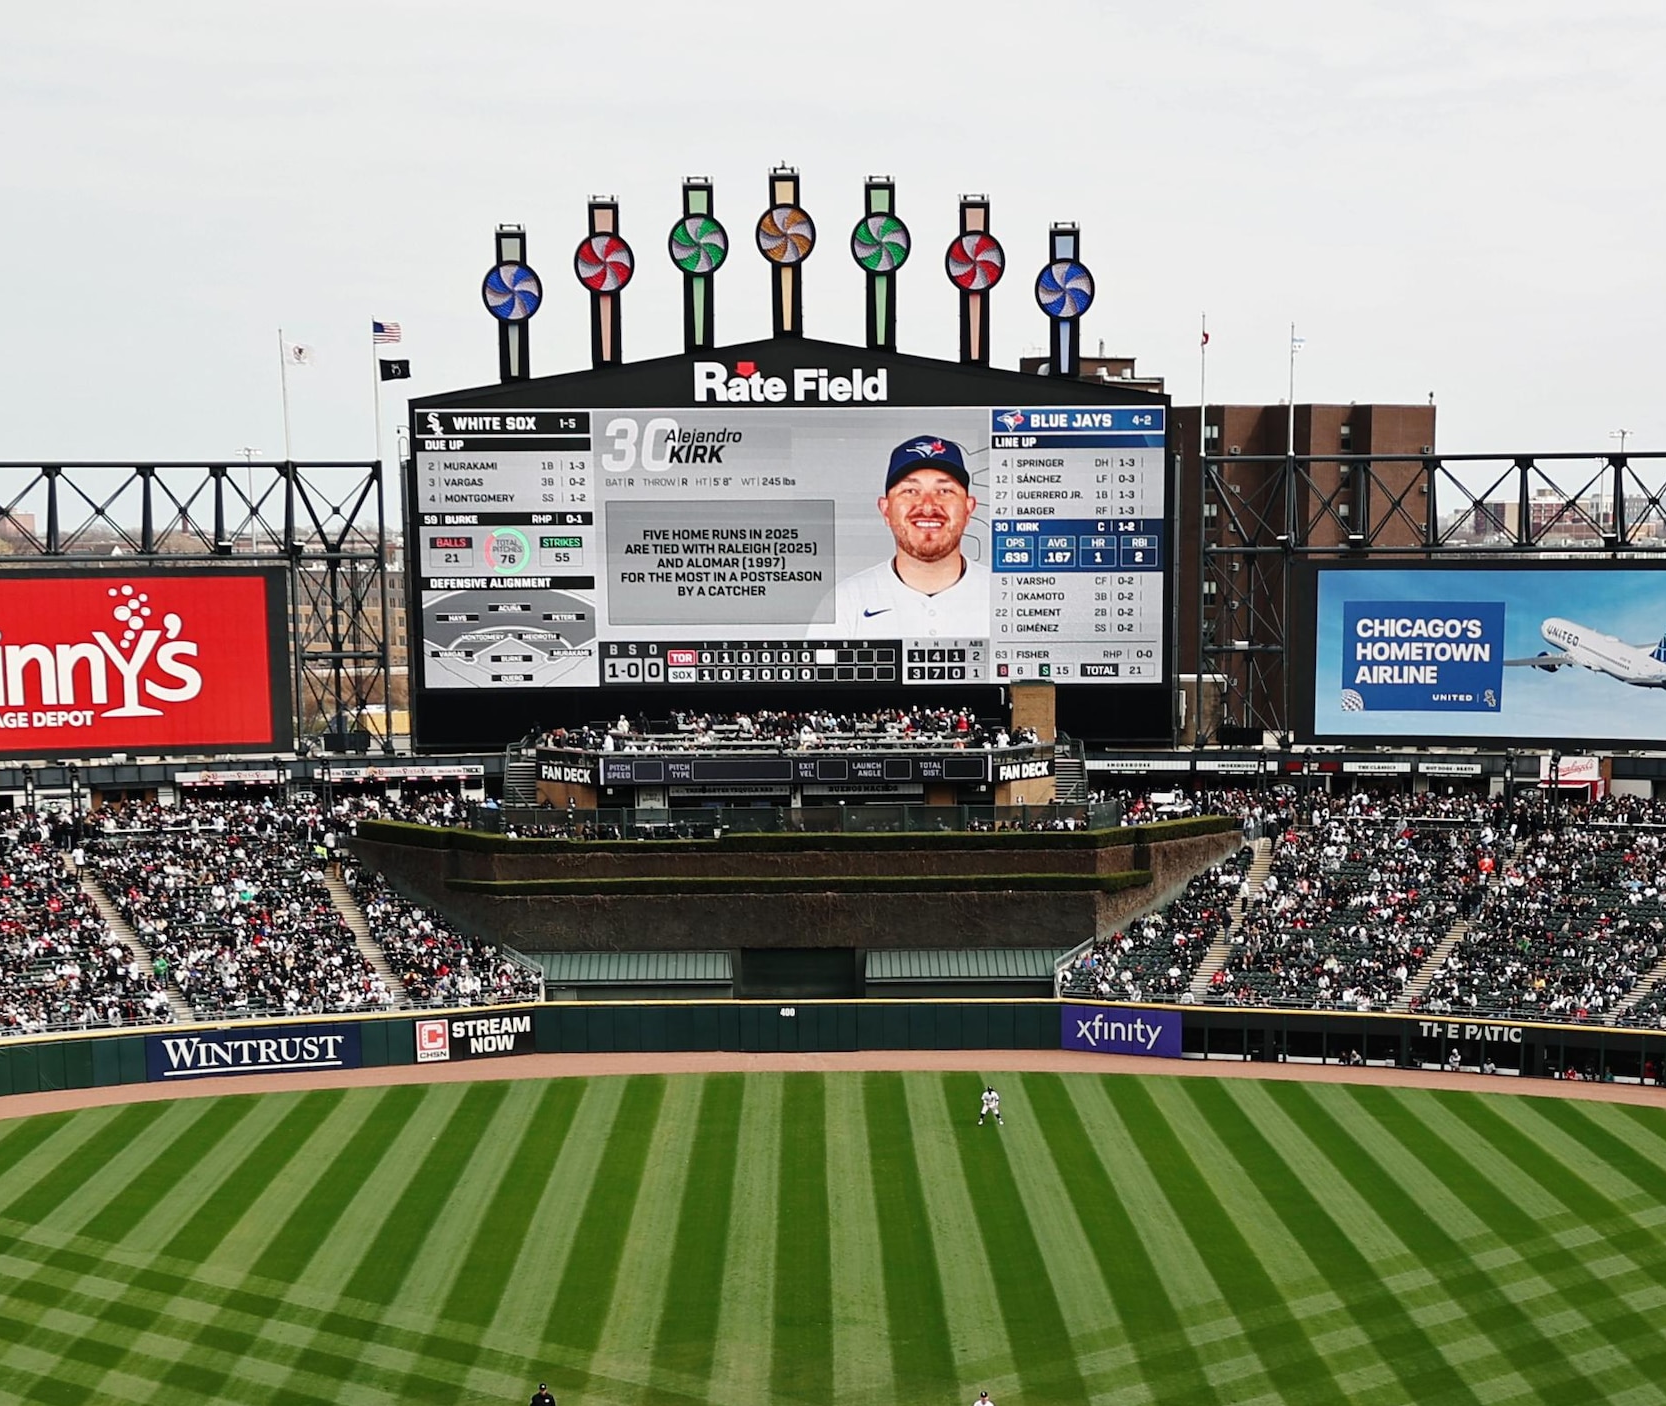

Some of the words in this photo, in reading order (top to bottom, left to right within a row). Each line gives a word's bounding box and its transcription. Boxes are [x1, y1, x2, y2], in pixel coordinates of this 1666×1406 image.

[693, 361, 787, 402] Rate
[793, 368, 888, 401] Field
[453, 417, 501, 430] WHITE
[506, 417, 536, 430] SOX
[1031, 414, 1068, 428] BLUE
[1072, 414, 1112, 427] JAYS
[665, 428, 742, 446] Alejandro
[669, 445, 725, 463] KIRK
[643, 530, 669, 540] FIVE
[673, 529, 709, 540] HOME
[712, 529, 746, 540] RUNS
[749, 529, 762, 539] IN
[765, 529, 799, 539] 2025
[625, 544, 649, 555] ARE
[652, 544, 679, 554] TIED
[683, 544, 714, 554] WITH
[718, 544, 770, 553] RALEIGH
[657, 558, 683, 568] AND
[687, 558, 739, 568] ALOMAR
[621, 573, 645, 583] FOR
[649, 572, 672, 582] THE
[676, 572, 711, 582] MOST
[714, 572, 726, 582] IN
[729, 572, 738, 582] A
[741, 571, 822, 582] POSTSEASON
[678, 586, 694, 596] BY
[697, 586, 706, 596] A
[709, 586, 766, 596] CATCHER
[1356, 618, 1483, 639] CHICAGO'S
[1356, 641, 1490, 663] HOMETOWN
[1355, 665, 1438, 685] AIRLINE
[1432, 694, 1473, 702] UNITED
[32, 710, 94, 728] DEPOT
[542, 765, 562, 781] FAN
[563, 766, 591, 784] DECK
[1000, 764, 1020, 781] FAN
[1022, 761, 1049, 777] DECK
[779, 1007, 795, 1018] 400
[451, 1015, 531, 1038] STREAM
[1076, 1013, 1163, 1050] xfinity
[162, 1034, 344, 1070] WINTRUST
[470, 1033, 515, 1054] NOW
[419, 1050, 448, 1060] CHSN
